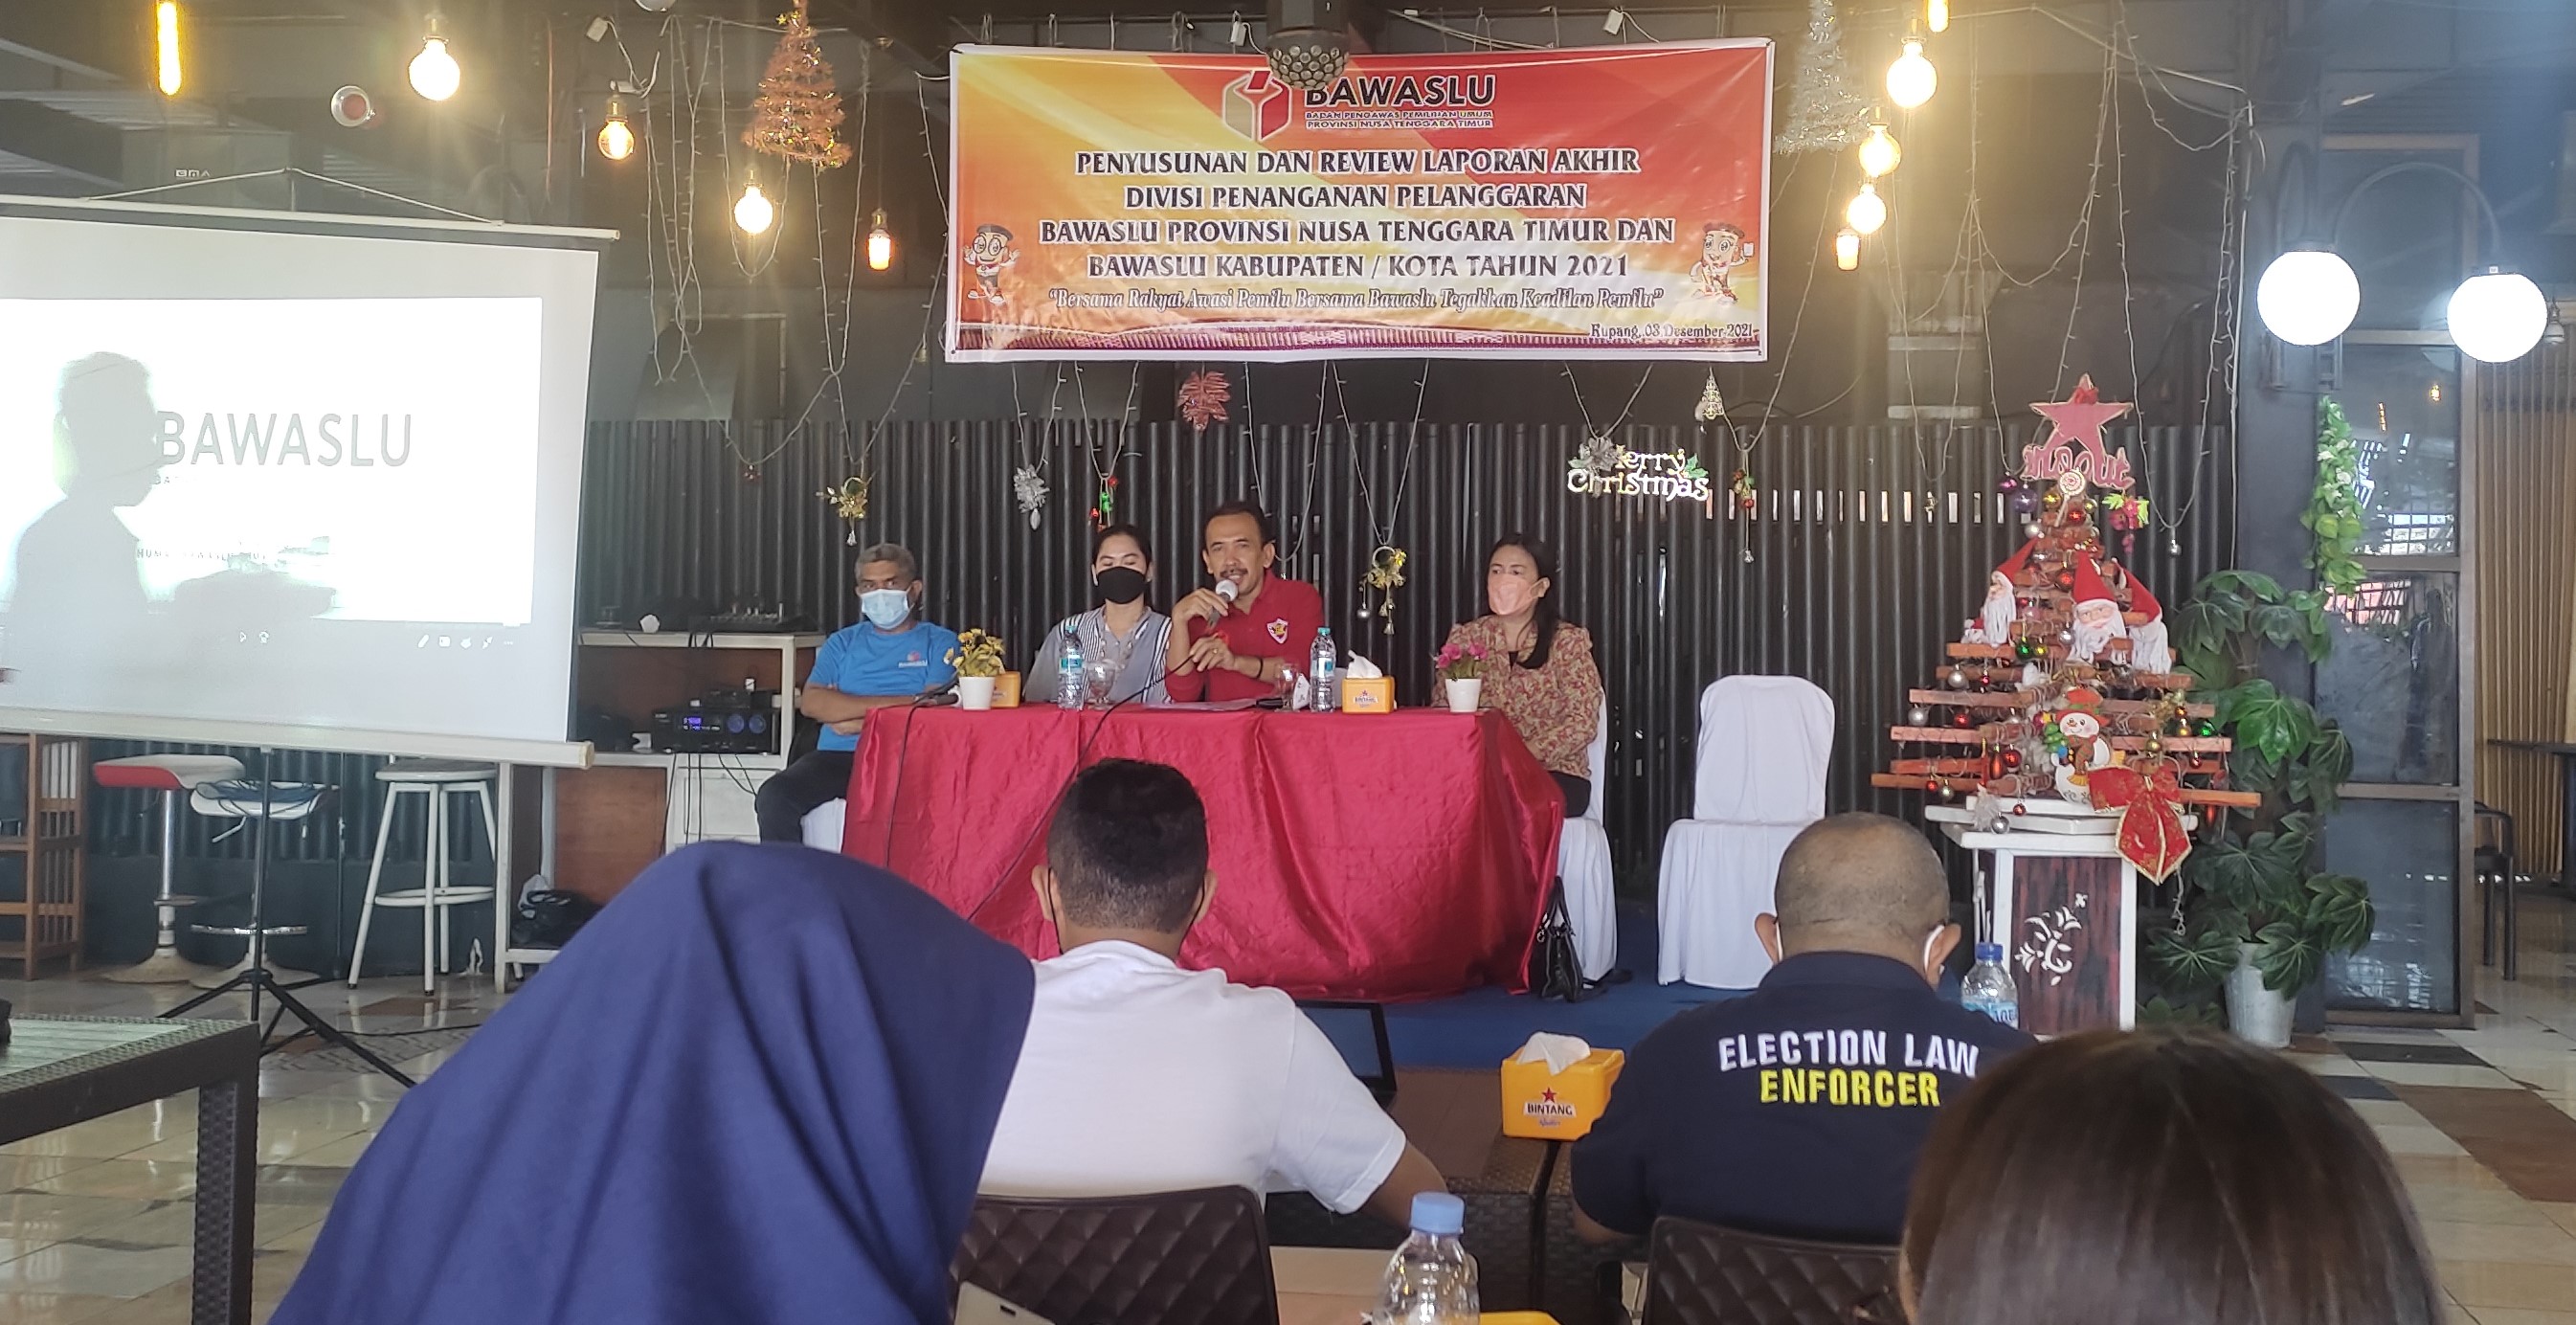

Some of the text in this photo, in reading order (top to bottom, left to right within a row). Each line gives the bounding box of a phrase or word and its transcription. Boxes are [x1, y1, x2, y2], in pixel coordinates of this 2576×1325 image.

[1306, 77, 1494, 106] BAWASLU
[1077, 149, 1640, 174] PENYUSUNAN DAN REVIEW LAPORAN AKHIR
[1126, 185, 1587, 208] DIVISI PENANGANAN PELANGGARAN
[1041, 219, 1675, 243] BAWASLU PROVINSI NUSA TENGGARA TIMUR DAN
[1088, 254, 1627, 278] BAWASLU KABUPATEN / KOTA TAHUN 2021
[1128, 288, 1184, 312] Rakyat
[1188, 289, 1233, 308] Awasi
[1237, 288, 1291, 308] Pemilu
[1295, 288, 1365, 308] Bersama
[1367, 288, 1436, 308] Bawaslu
[1440, 288, 1518, 313] Tegakkan
[1520, 288, 1594, 308] Keadilan
[1664, 324, 1724, 337] Desember
[1726, 324, 1753, 337] 2021
[156, 410, 412, 467] BAWASLU
[1603, 443, 1687, 478] erry
[1567, 467, 1710, 502] Christmas
[1718, 1029, 1980, 1079] ELECTION LAW
[1760, 1067, 1940, 1108] ENFORCER
[1527, 1103, 1573, 1116] BINTANG
